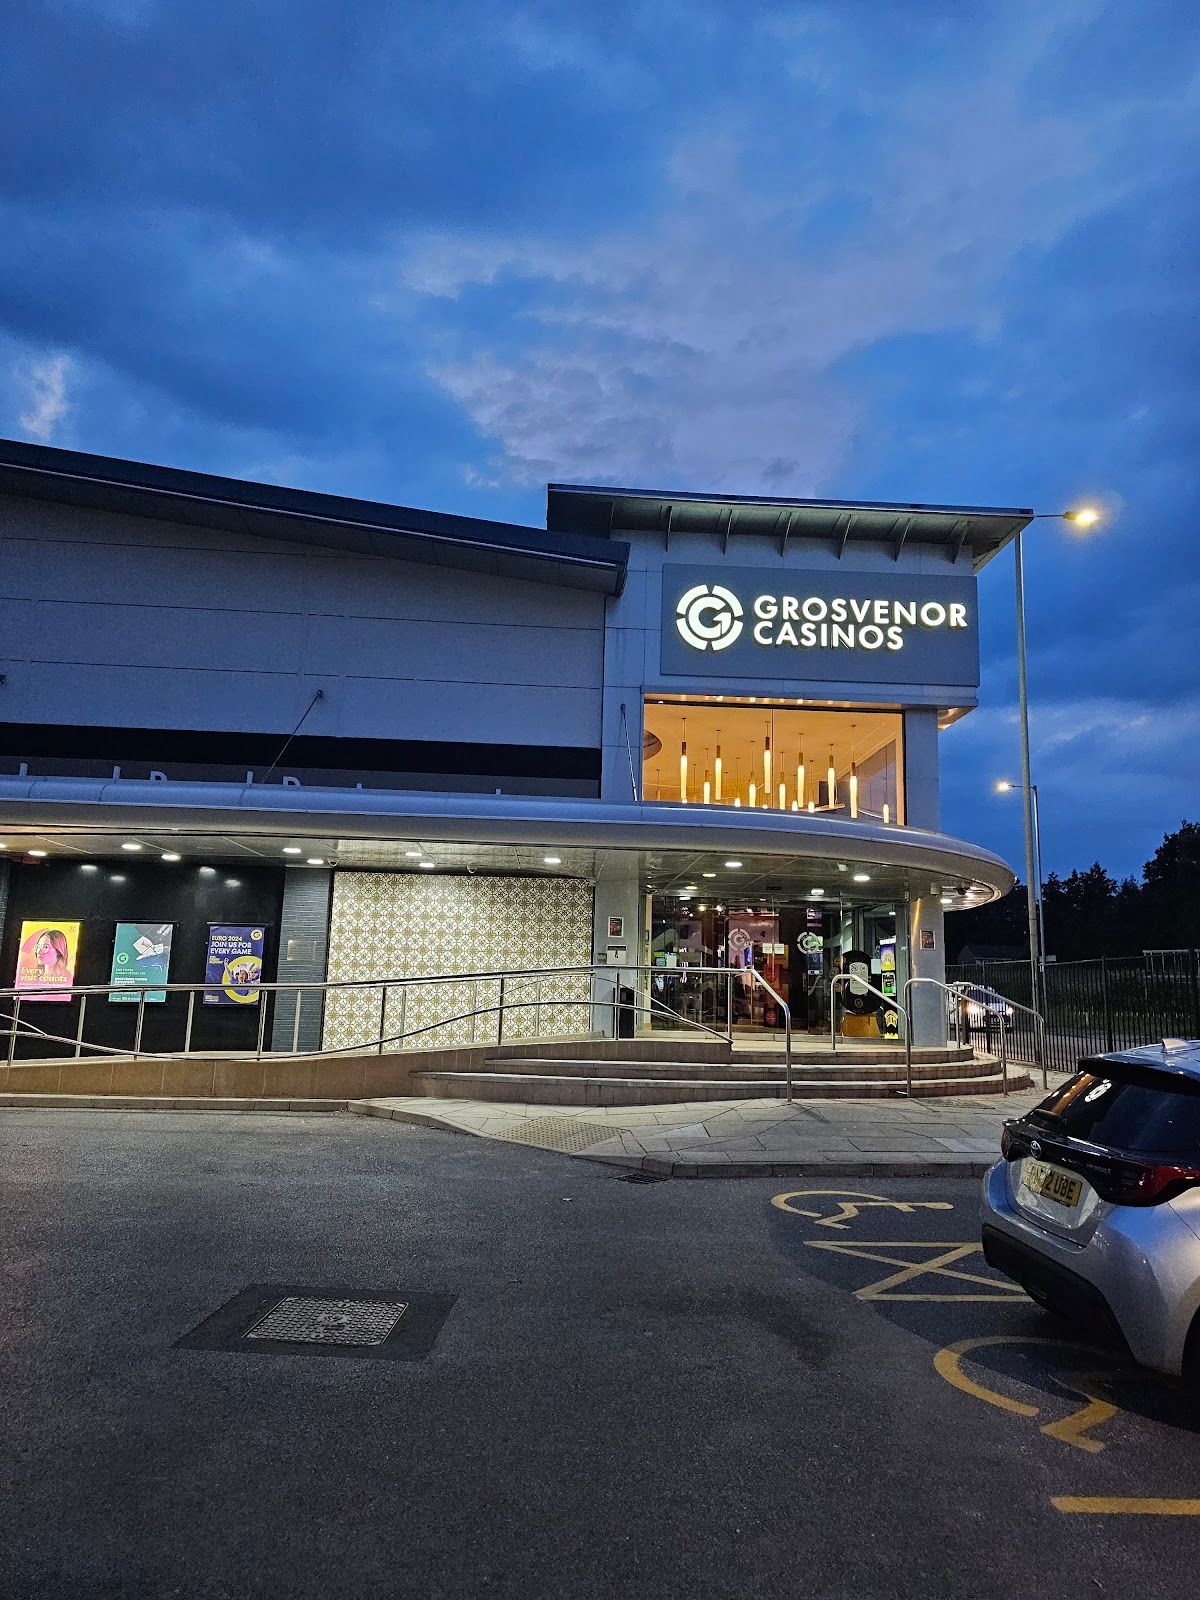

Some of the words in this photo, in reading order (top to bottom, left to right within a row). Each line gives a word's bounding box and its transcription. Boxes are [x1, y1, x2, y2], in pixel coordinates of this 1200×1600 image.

[753, 595, 968, 628] GROSVENOR
[753, 621, 904, 650] CASINOS
[21, 967, 44, 977] Every
[39, 975, 68, 983] counts
